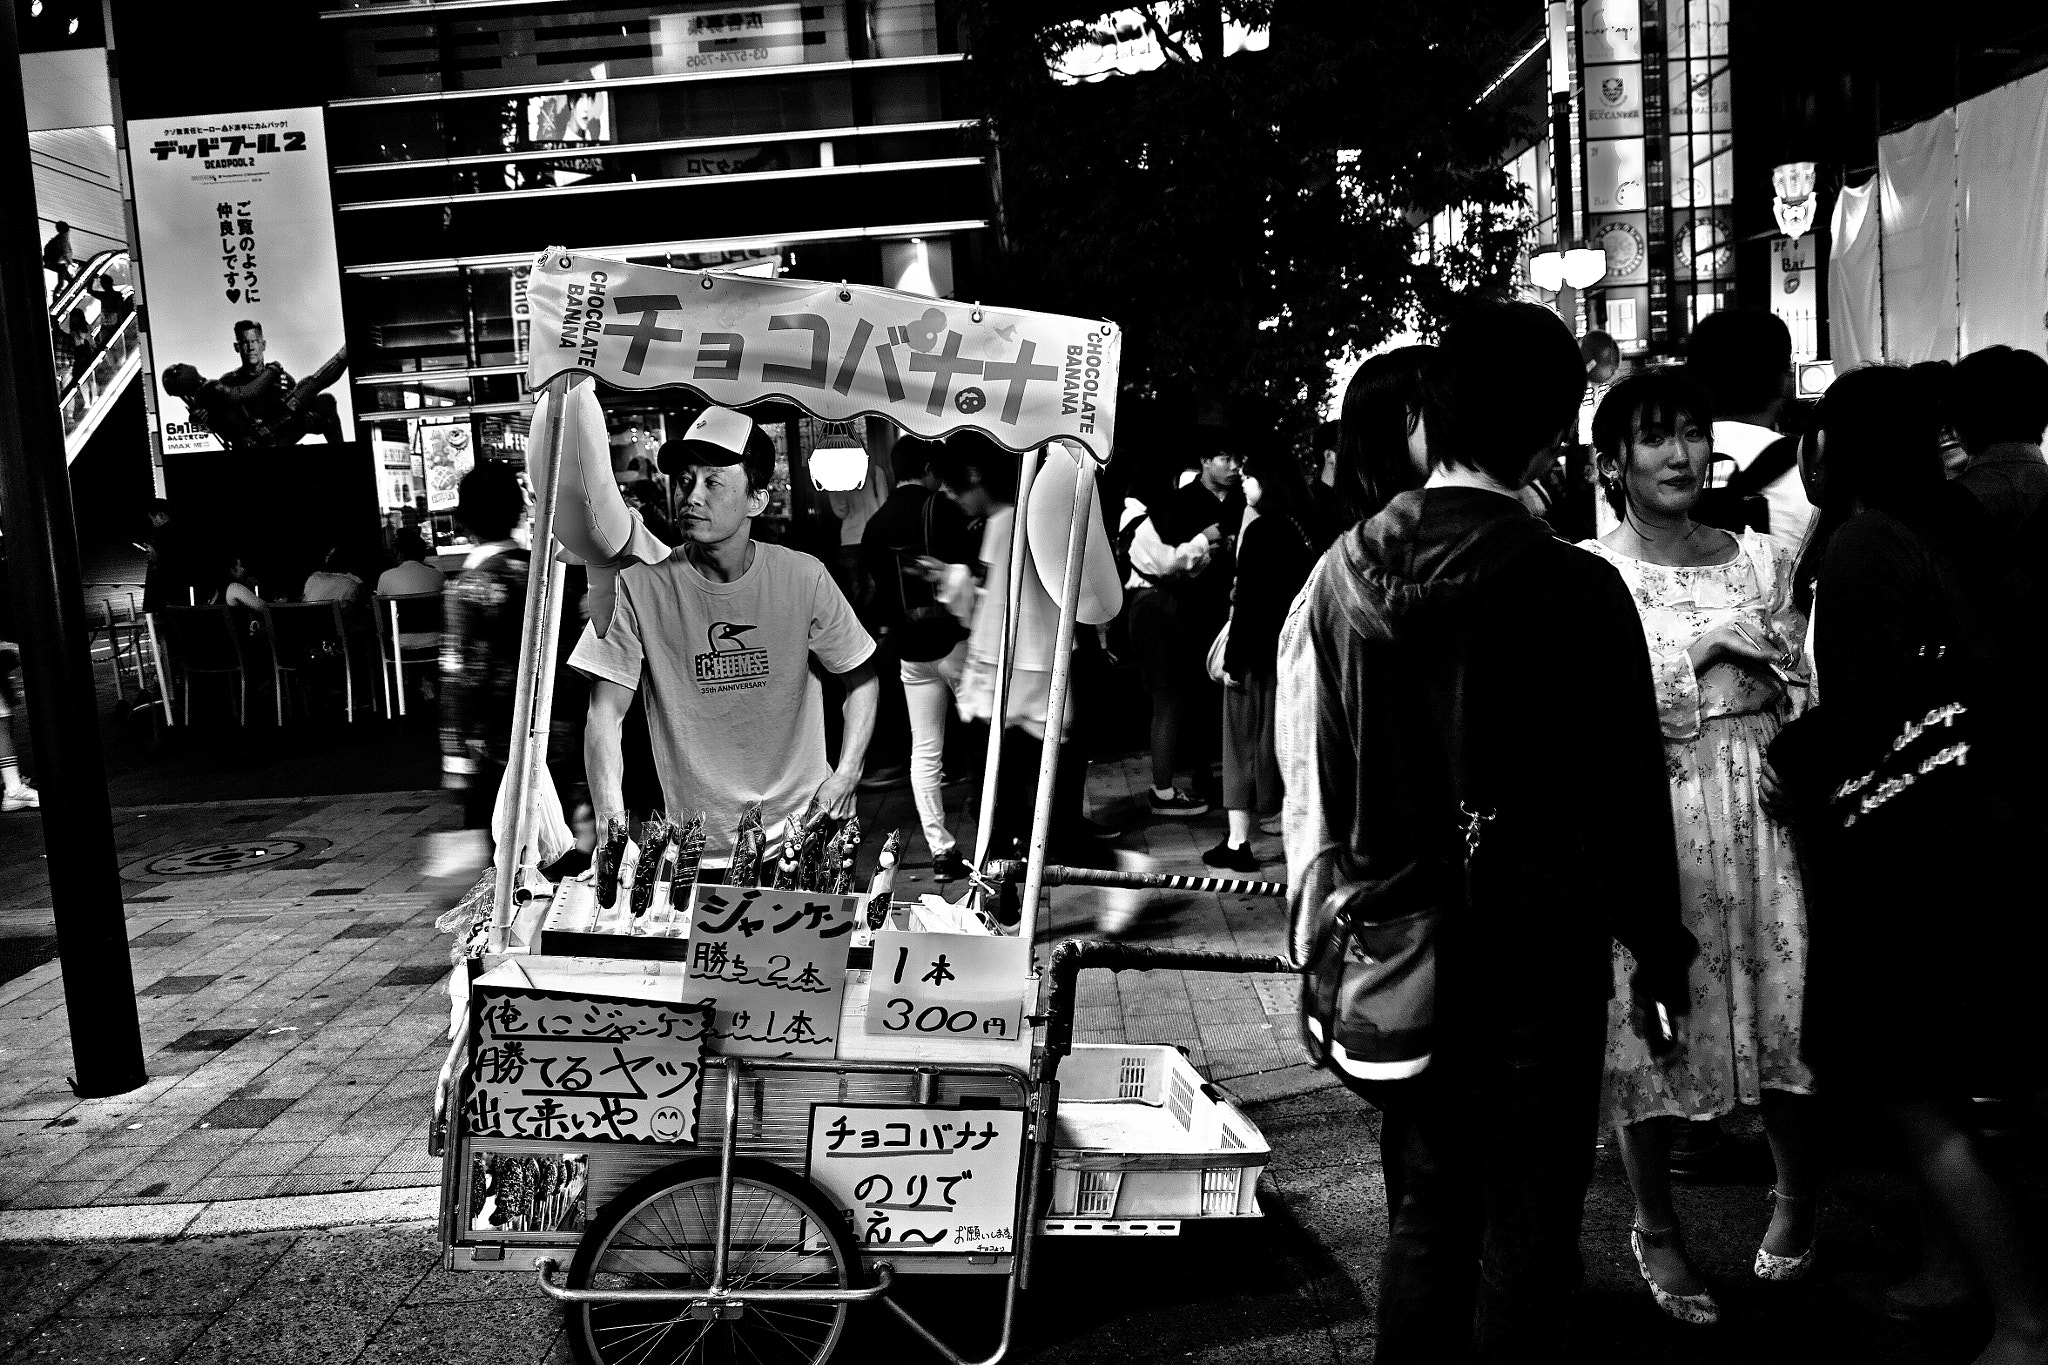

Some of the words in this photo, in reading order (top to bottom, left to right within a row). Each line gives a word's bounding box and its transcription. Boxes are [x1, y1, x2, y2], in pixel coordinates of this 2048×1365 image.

[204, 158, 248, 169] DEADPOOL
[237, 200, 261, 304] ご覧のように
[577, 271, 608, 368] CHOCOLATE
[602, 294, 1059, 425] チョコバナナ
[1061, 345, 1083, 415] BANANA
[1079, 332, 1102, 434] CHOCOLATE
[701, 687, 717, 695] 35th
[717, 680, 767, 693] ANNIVERSARY
[702, 653, 764, 680] CHUMS
[1918, 741, 1971, 774] way
[697, 889, 854, 939] ジャンケン
[693, 941, 749, 977] 勝ち
[484, 998, 712, 1042] 俺にジャンケン
[882, 998, 1006, 1036] 300円
[475, 1041, 699, 1098] 勝てるヤツ
[466, 1088, 639, 1140] 出て来いや
[826, 1115, 1000, 1151] チョコバナナ
[854, 1169, 973, 1208] のりで
